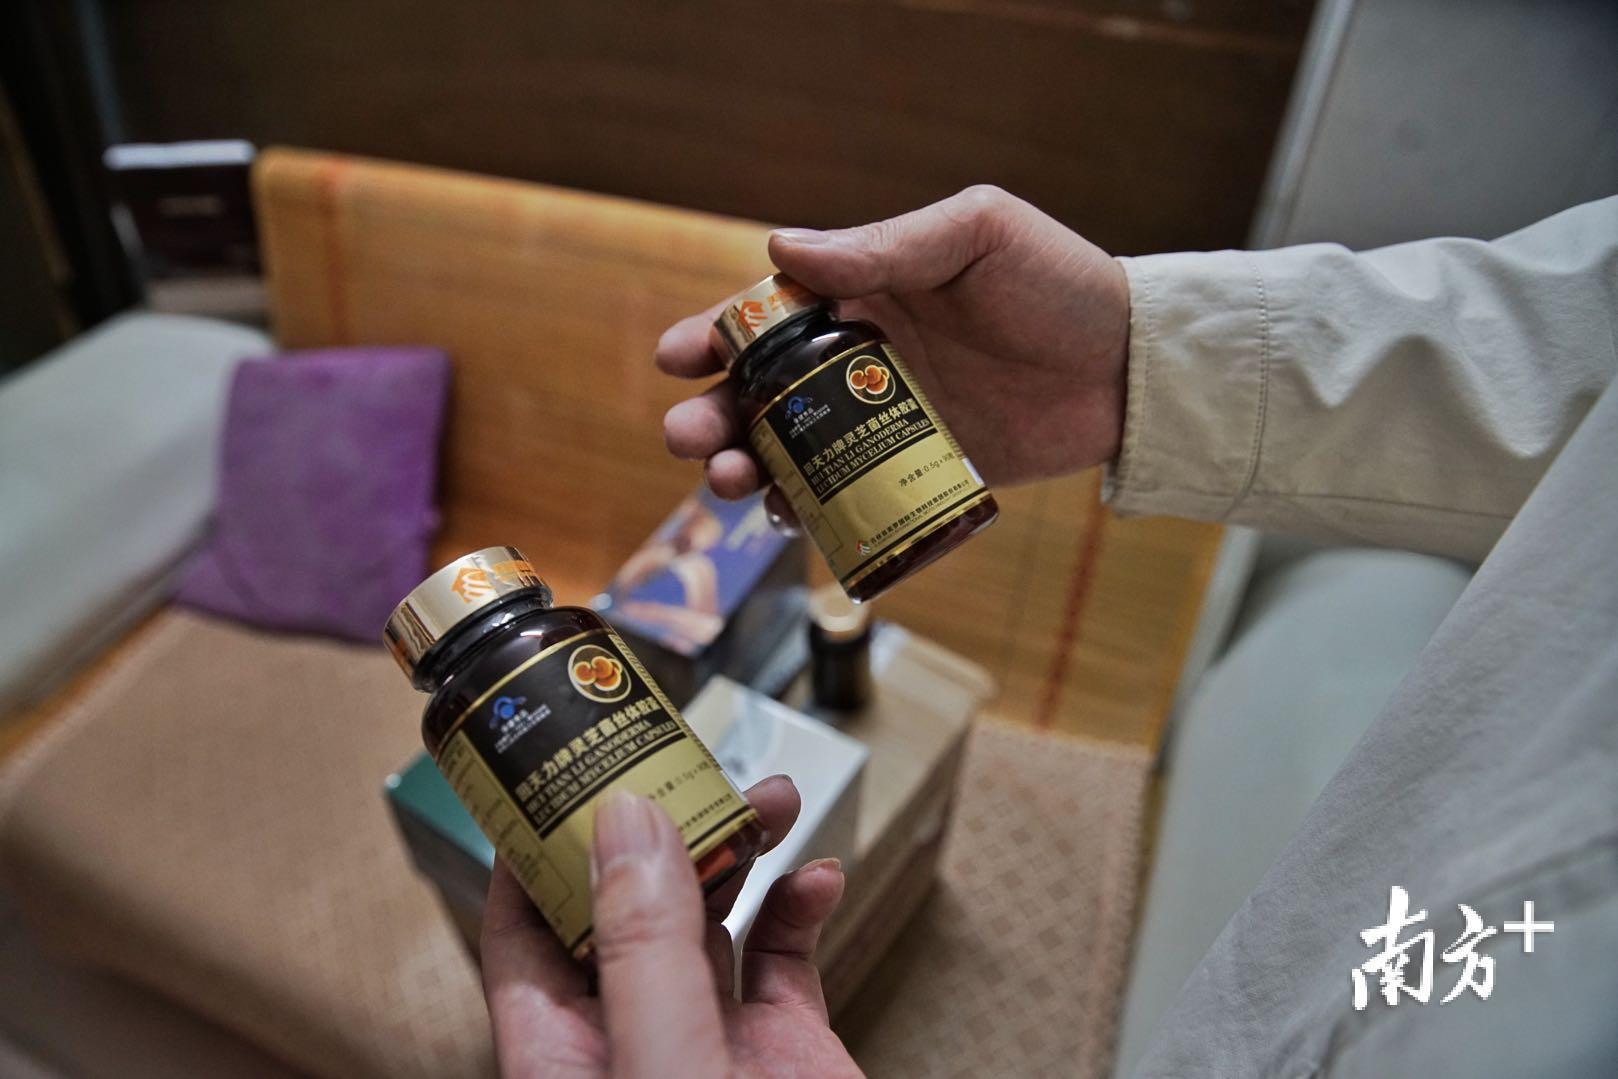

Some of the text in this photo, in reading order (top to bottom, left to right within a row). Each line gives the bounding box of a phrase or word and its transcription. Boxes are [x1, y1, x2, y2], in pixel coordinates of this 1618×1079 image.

[803, 397, 918, 475] 回天力牌灵芝菌丝体胶囊
[816, 418, 930, 493] LUCIDUM MYCELIUM CAPSULES
[823, 455, 845, 474] TIAN
[844, 449, 855, 460] LI
[855, 417, 908, 452] GANODERMA
